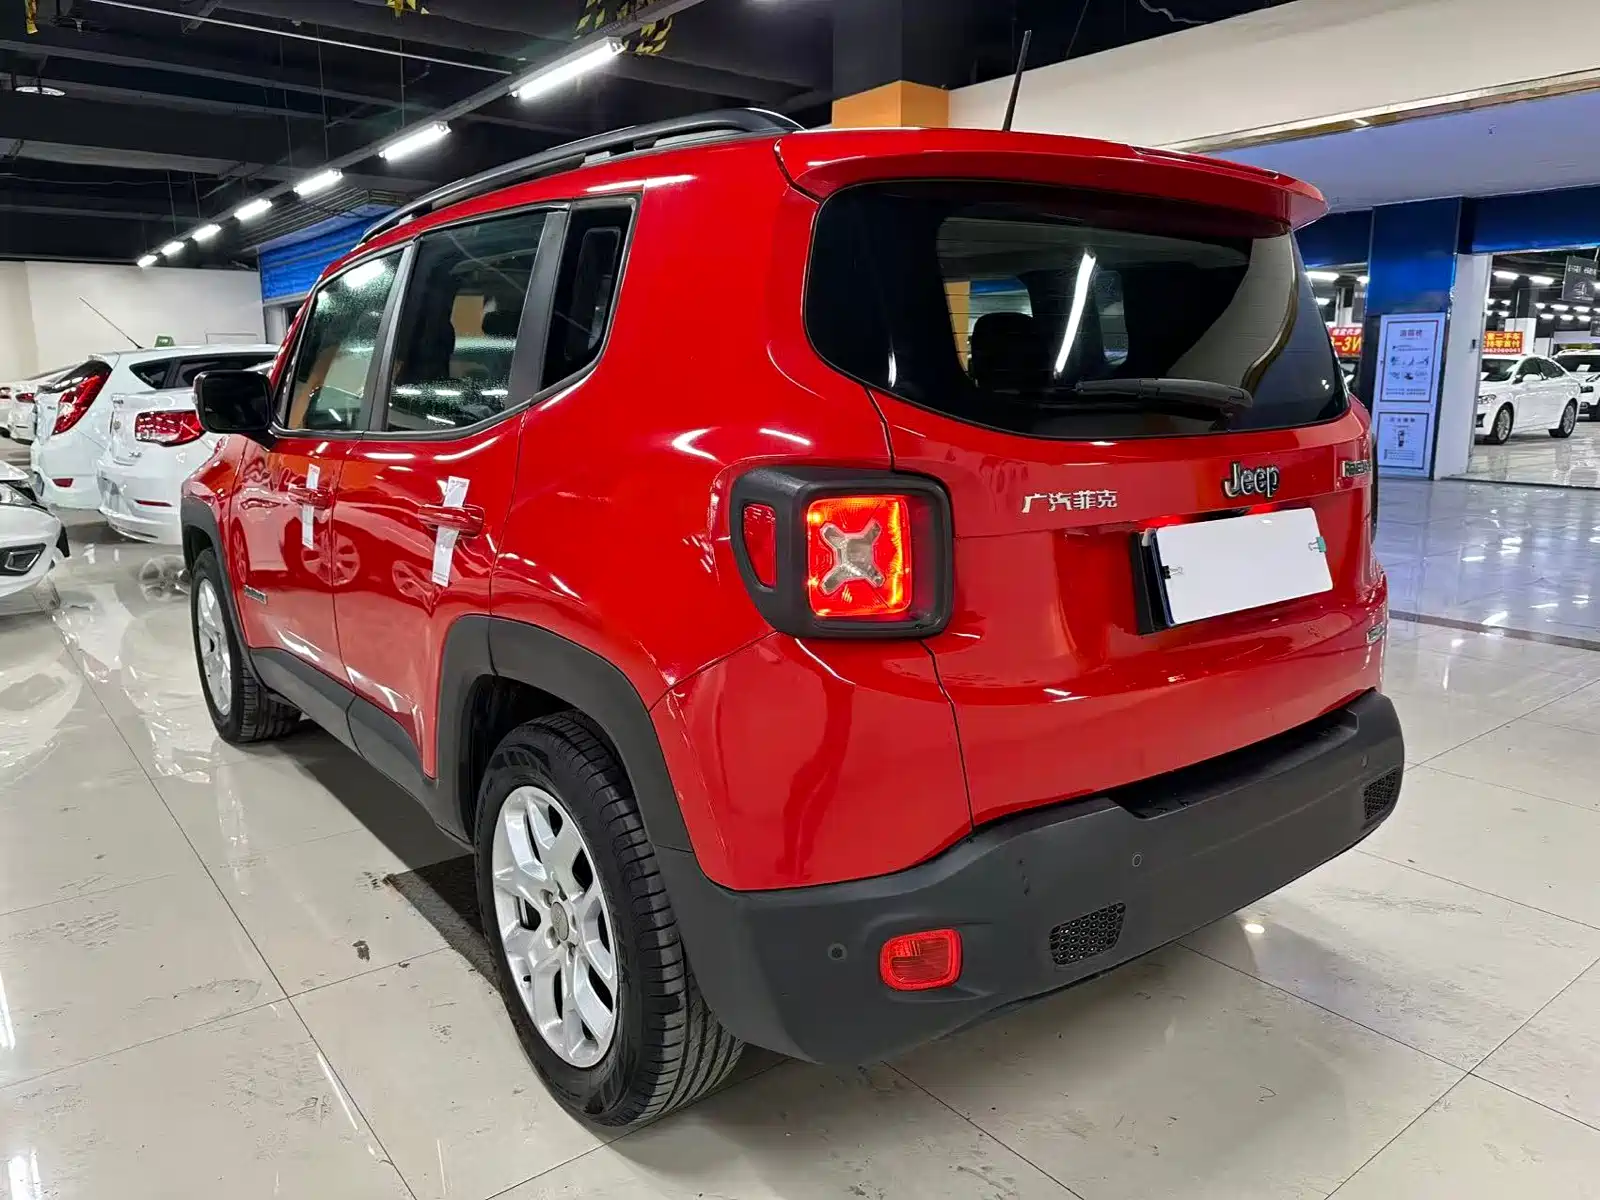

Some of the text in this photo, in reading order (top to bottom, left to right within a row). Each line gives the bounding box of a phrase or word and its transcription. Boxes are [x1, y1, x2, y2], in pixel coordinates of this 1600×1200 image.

[1224, 461, 1280, 499] Jeep
[1021, 489, 1118, 514] 广汽菲克
